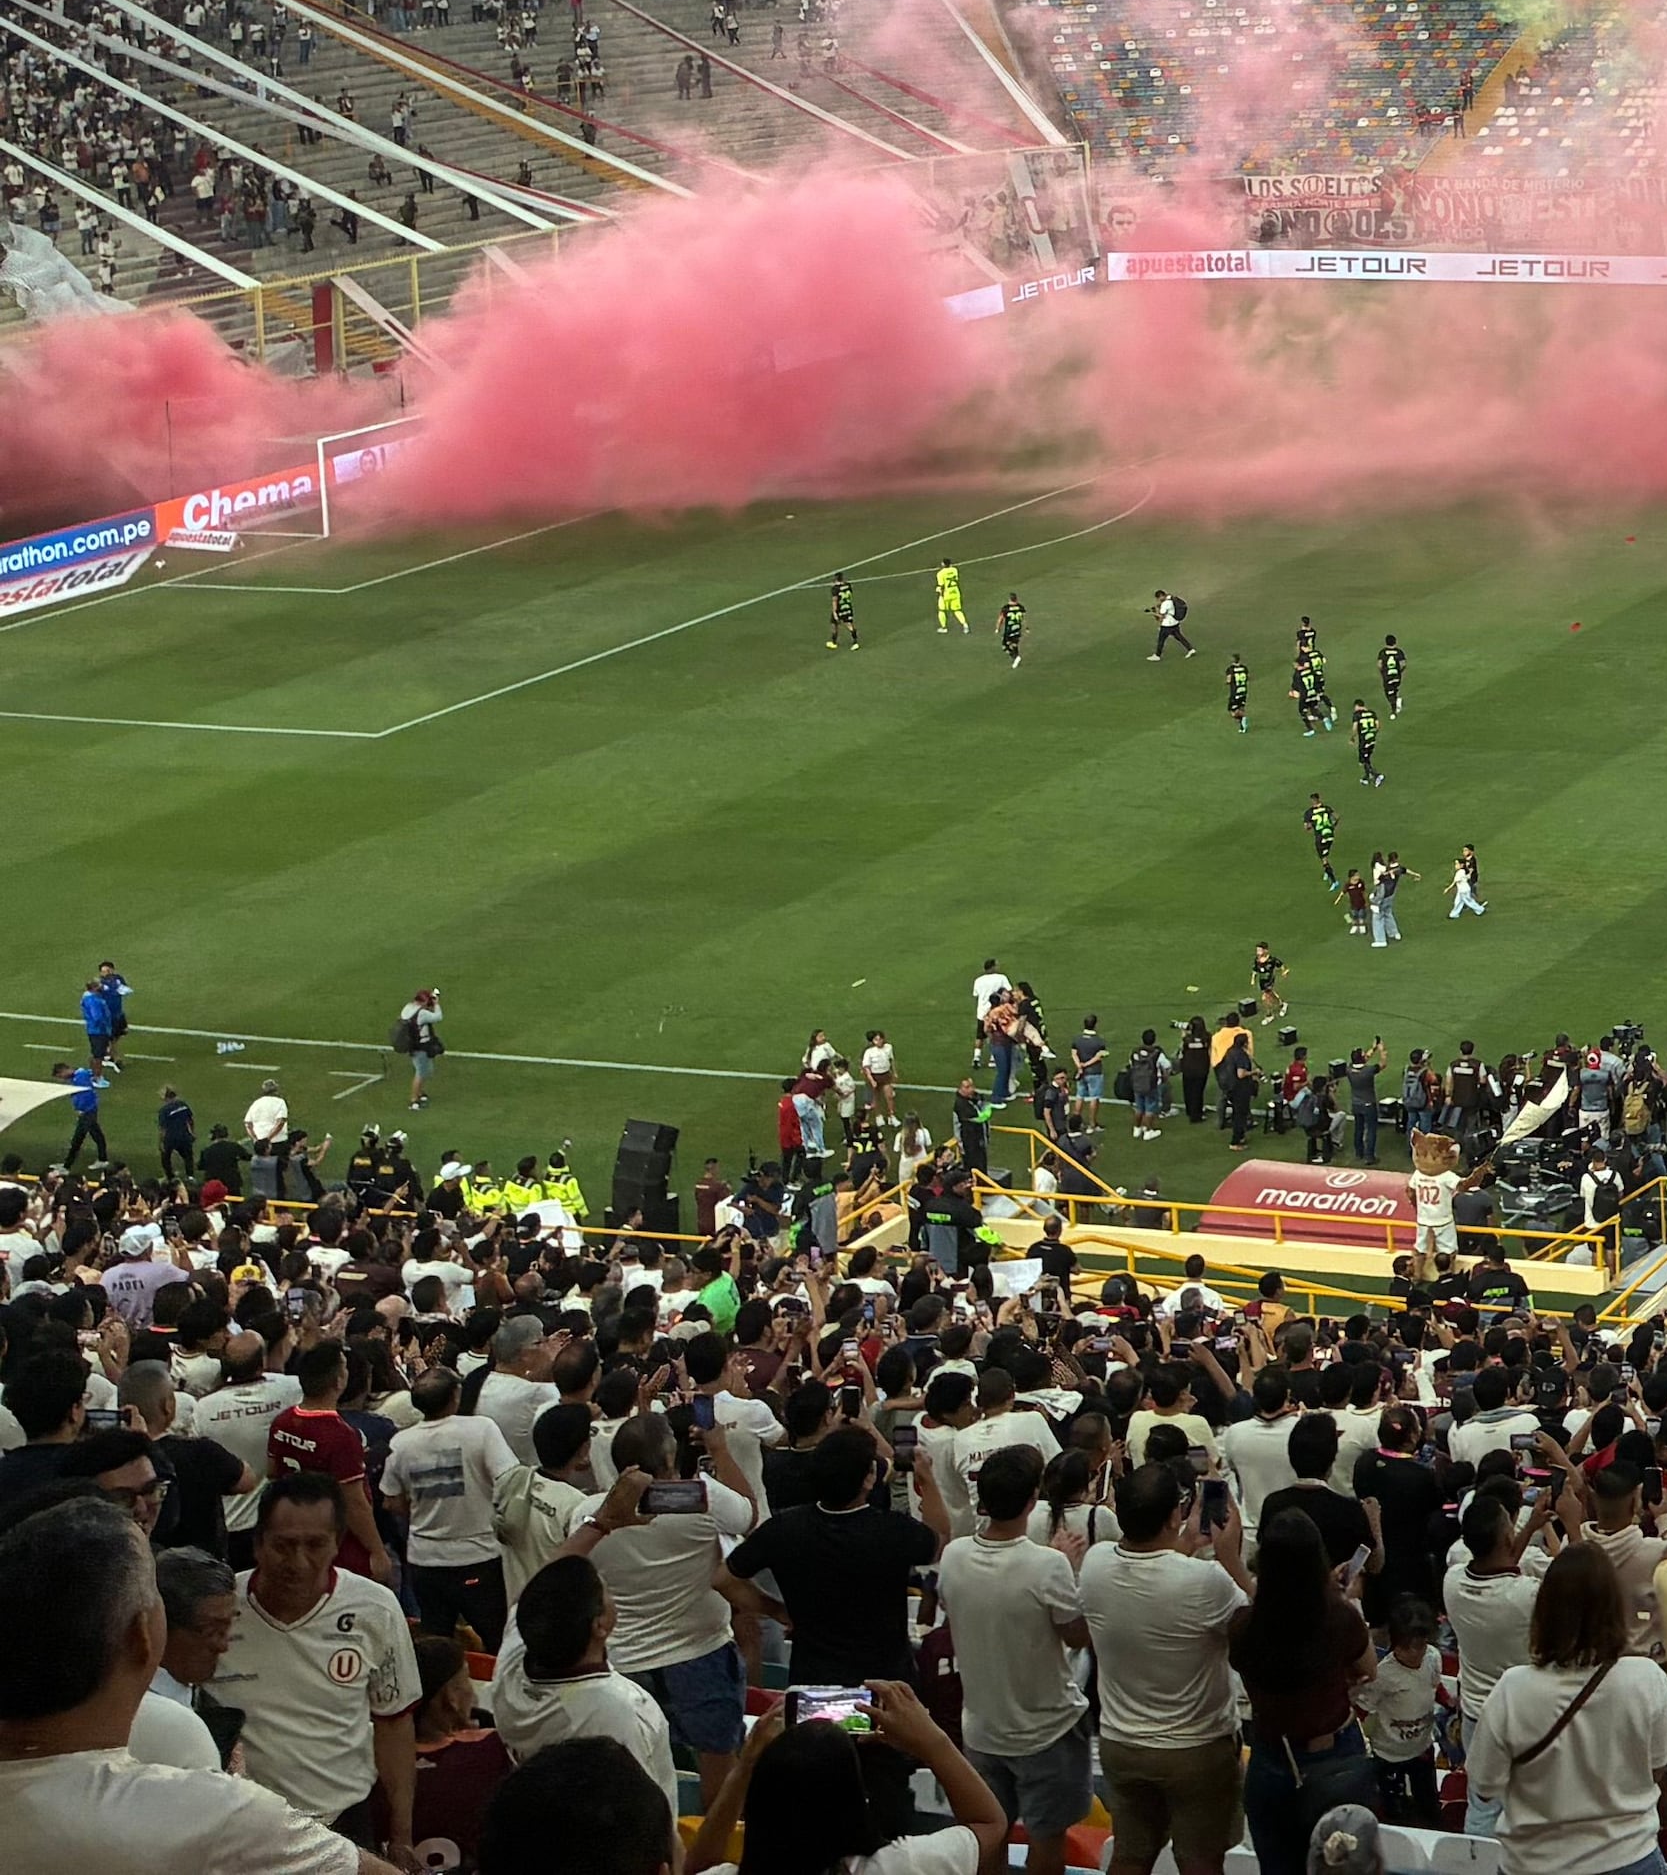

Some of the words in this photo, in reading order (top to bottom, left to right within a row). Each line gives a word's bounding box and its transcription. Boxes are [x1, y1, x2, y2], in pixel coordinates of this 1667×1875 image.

[1248, 178, 1283, 198] LOS
[1125, 251, 1253, 276] apuestatotal
[1295, 256, 1428, 275] JETOUR
[1476, 259, 1610, 278] JETOUR
[1012, 265, 1096, 304] JETOUR
[182, 474, 313, 532] Chema
[1255, 1187, 1398, 1216] marathon
[1417, 1184, 1441, 1206] 102
[210, 1401, 282, 1422] JETOUR
[273, 1429, 317, 1453] JETOUR
